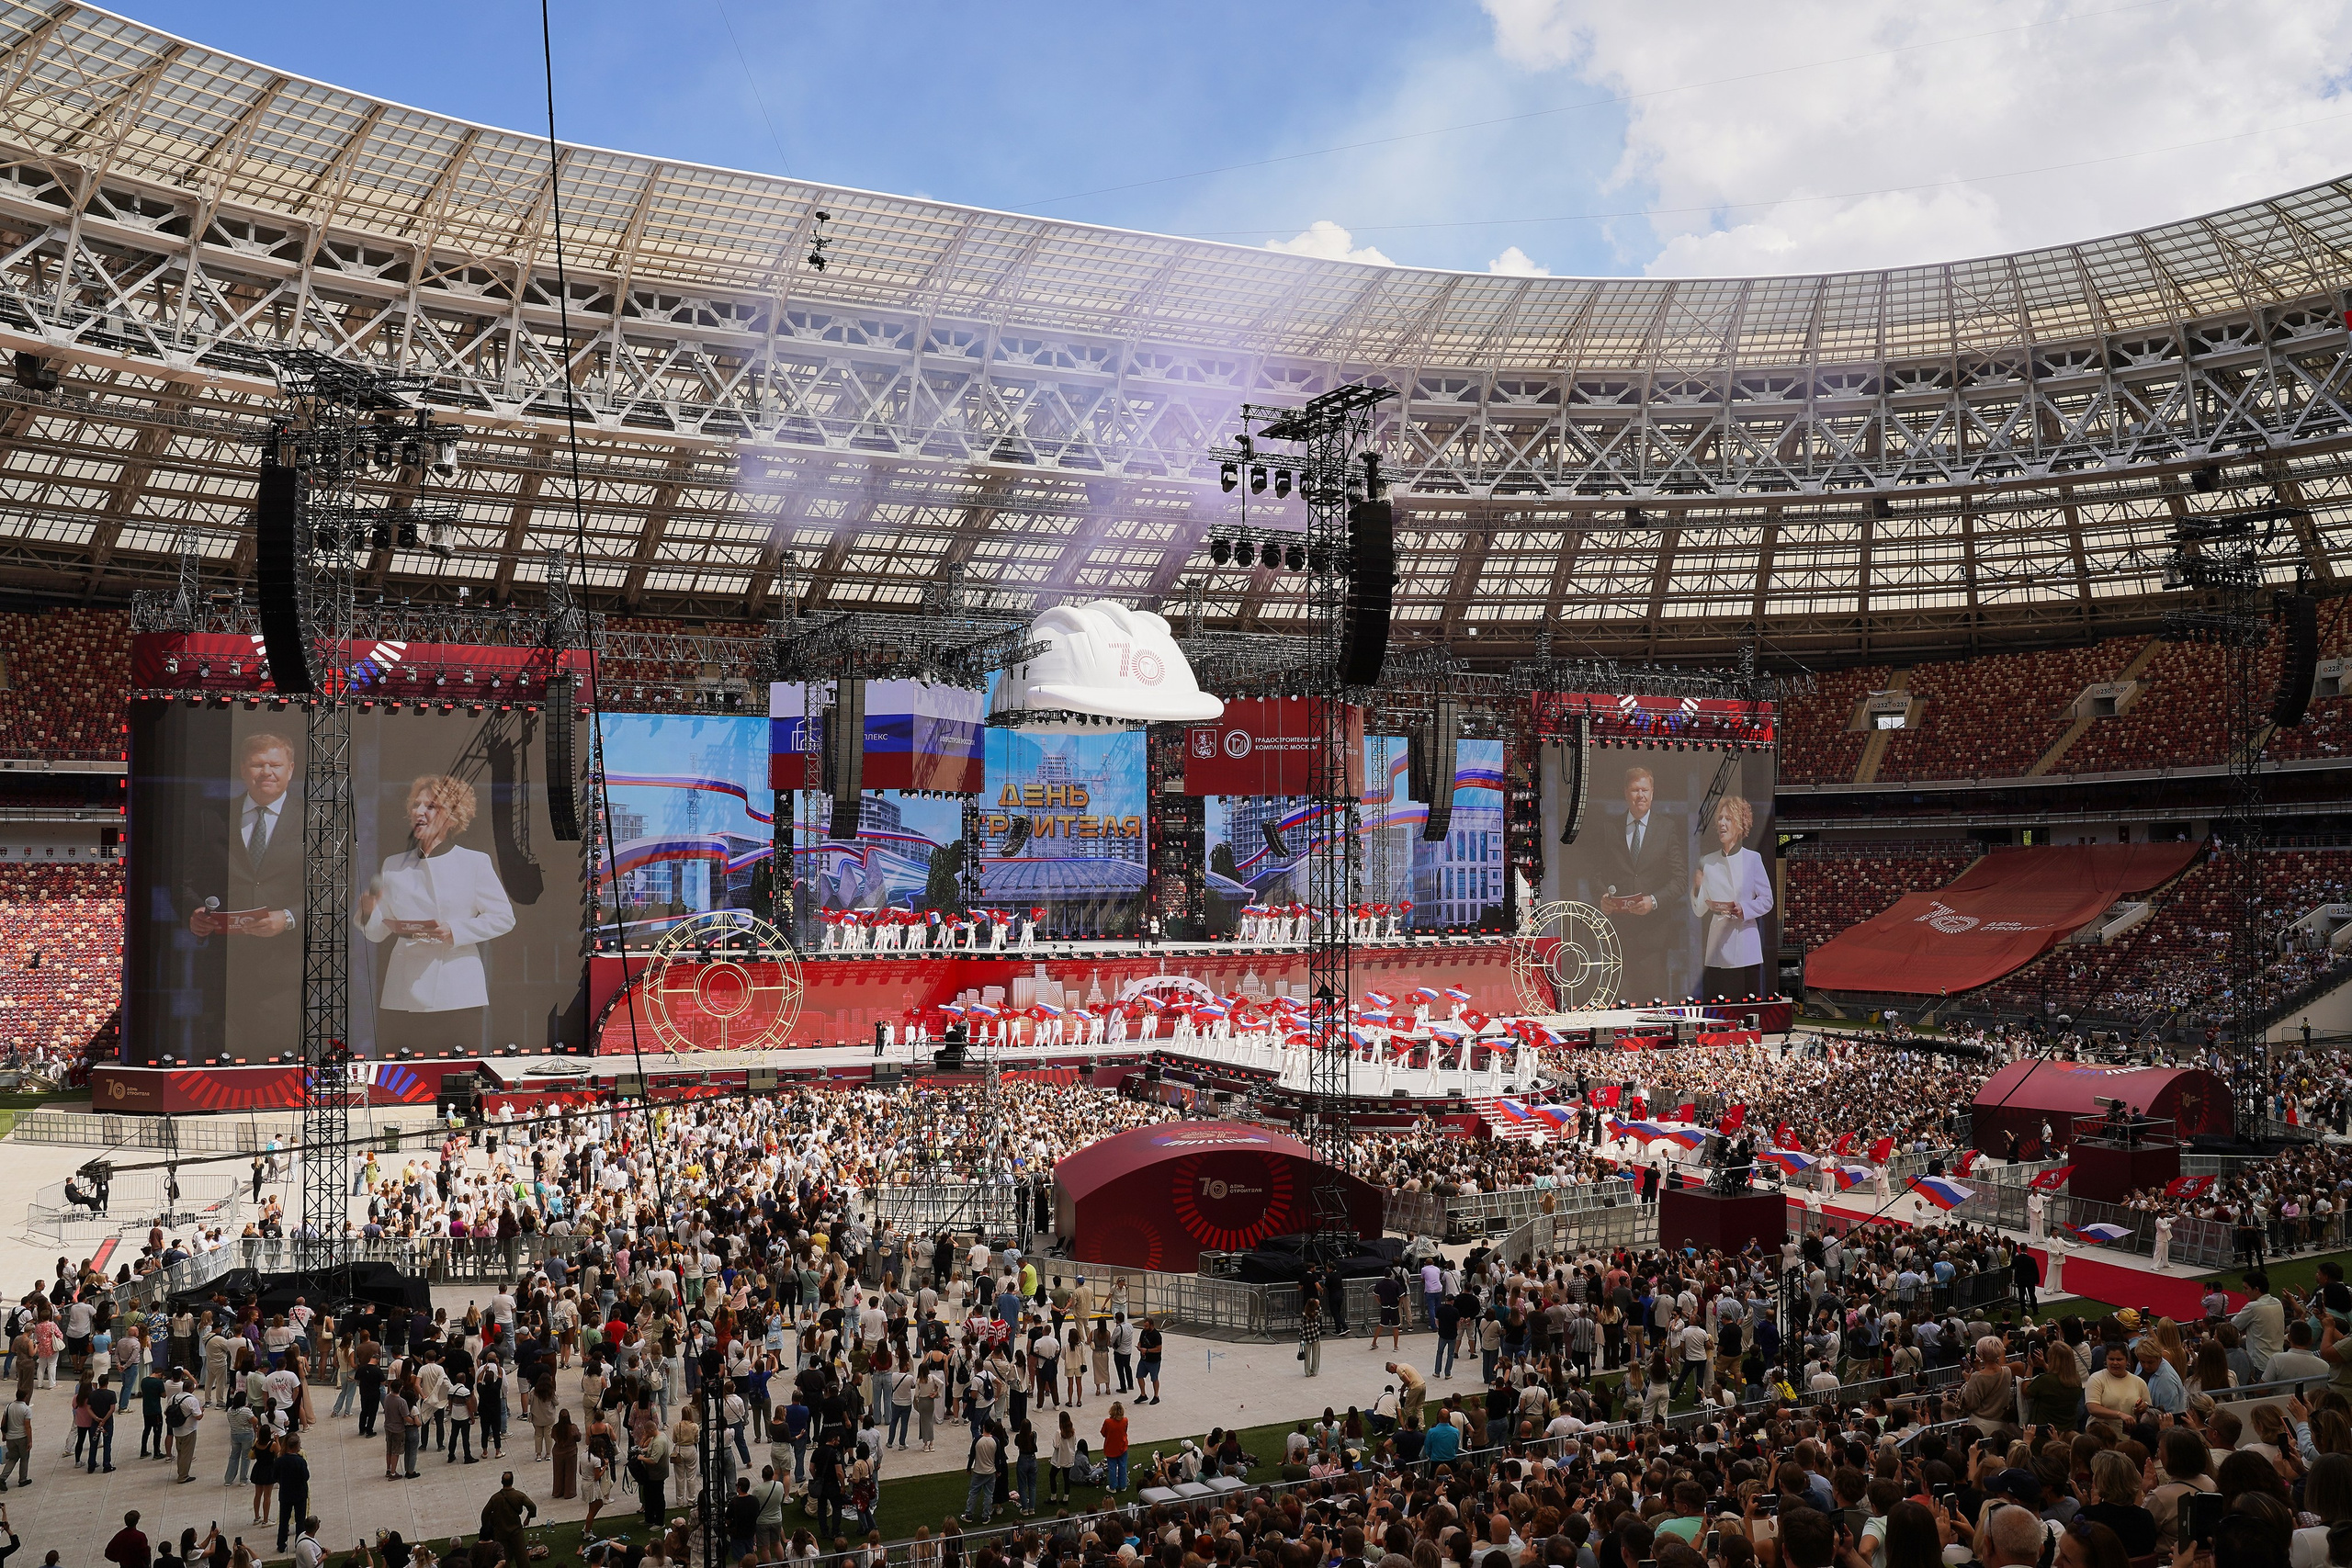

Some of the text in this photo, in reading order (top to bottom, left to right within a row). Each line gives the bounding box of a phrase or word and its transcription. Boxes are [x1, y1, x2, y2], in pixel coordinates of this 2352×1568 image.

[1108, 642, 1165, 686] 70
[998, 784, 1089, 807] ДЕНЬ
[106, 1078, 126, 1100] 70
[1199, 1177, 1227, 1199] 70
